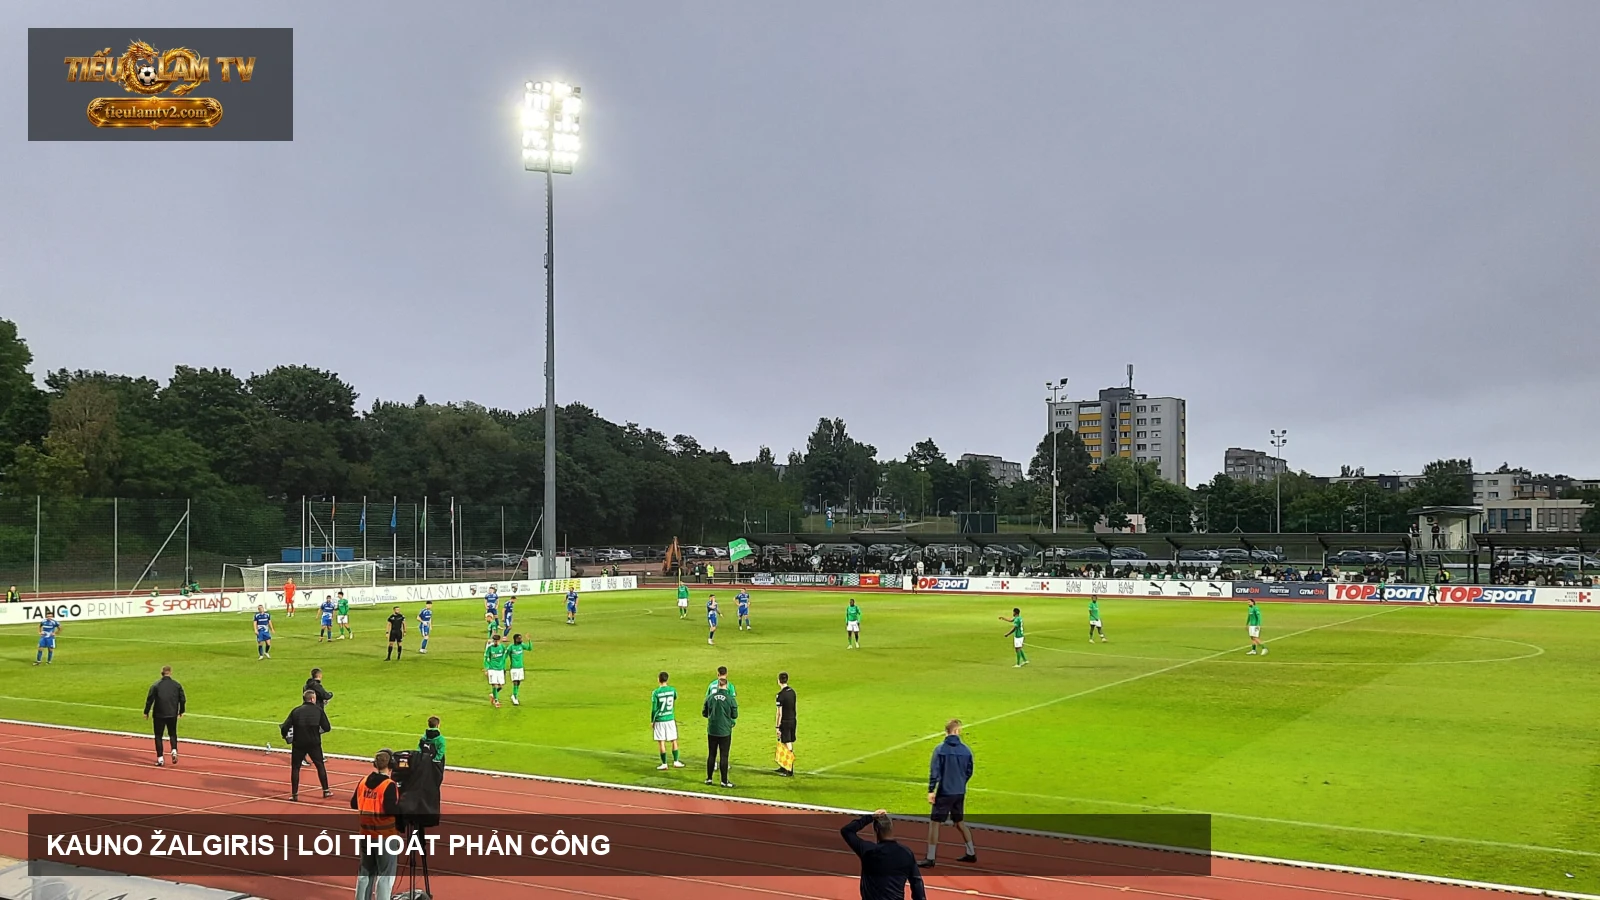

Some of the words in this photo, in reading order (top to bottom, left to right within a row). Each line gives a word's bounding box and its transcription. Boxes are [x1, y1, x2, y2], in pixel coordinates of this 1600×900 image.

[918, 577, 969, 589] OPsport
[407, 586, 433, 600] SALA
[438, 585, 463, 598] SALA
[1440, 586, 1534, 603] TOPsport
[23, 604, 81, 620] TANGO
[87, 601, 133, 616] PRINT
[162, 597, 231, 612] SPORTLAND
[659, 696, 674, 711] 79
